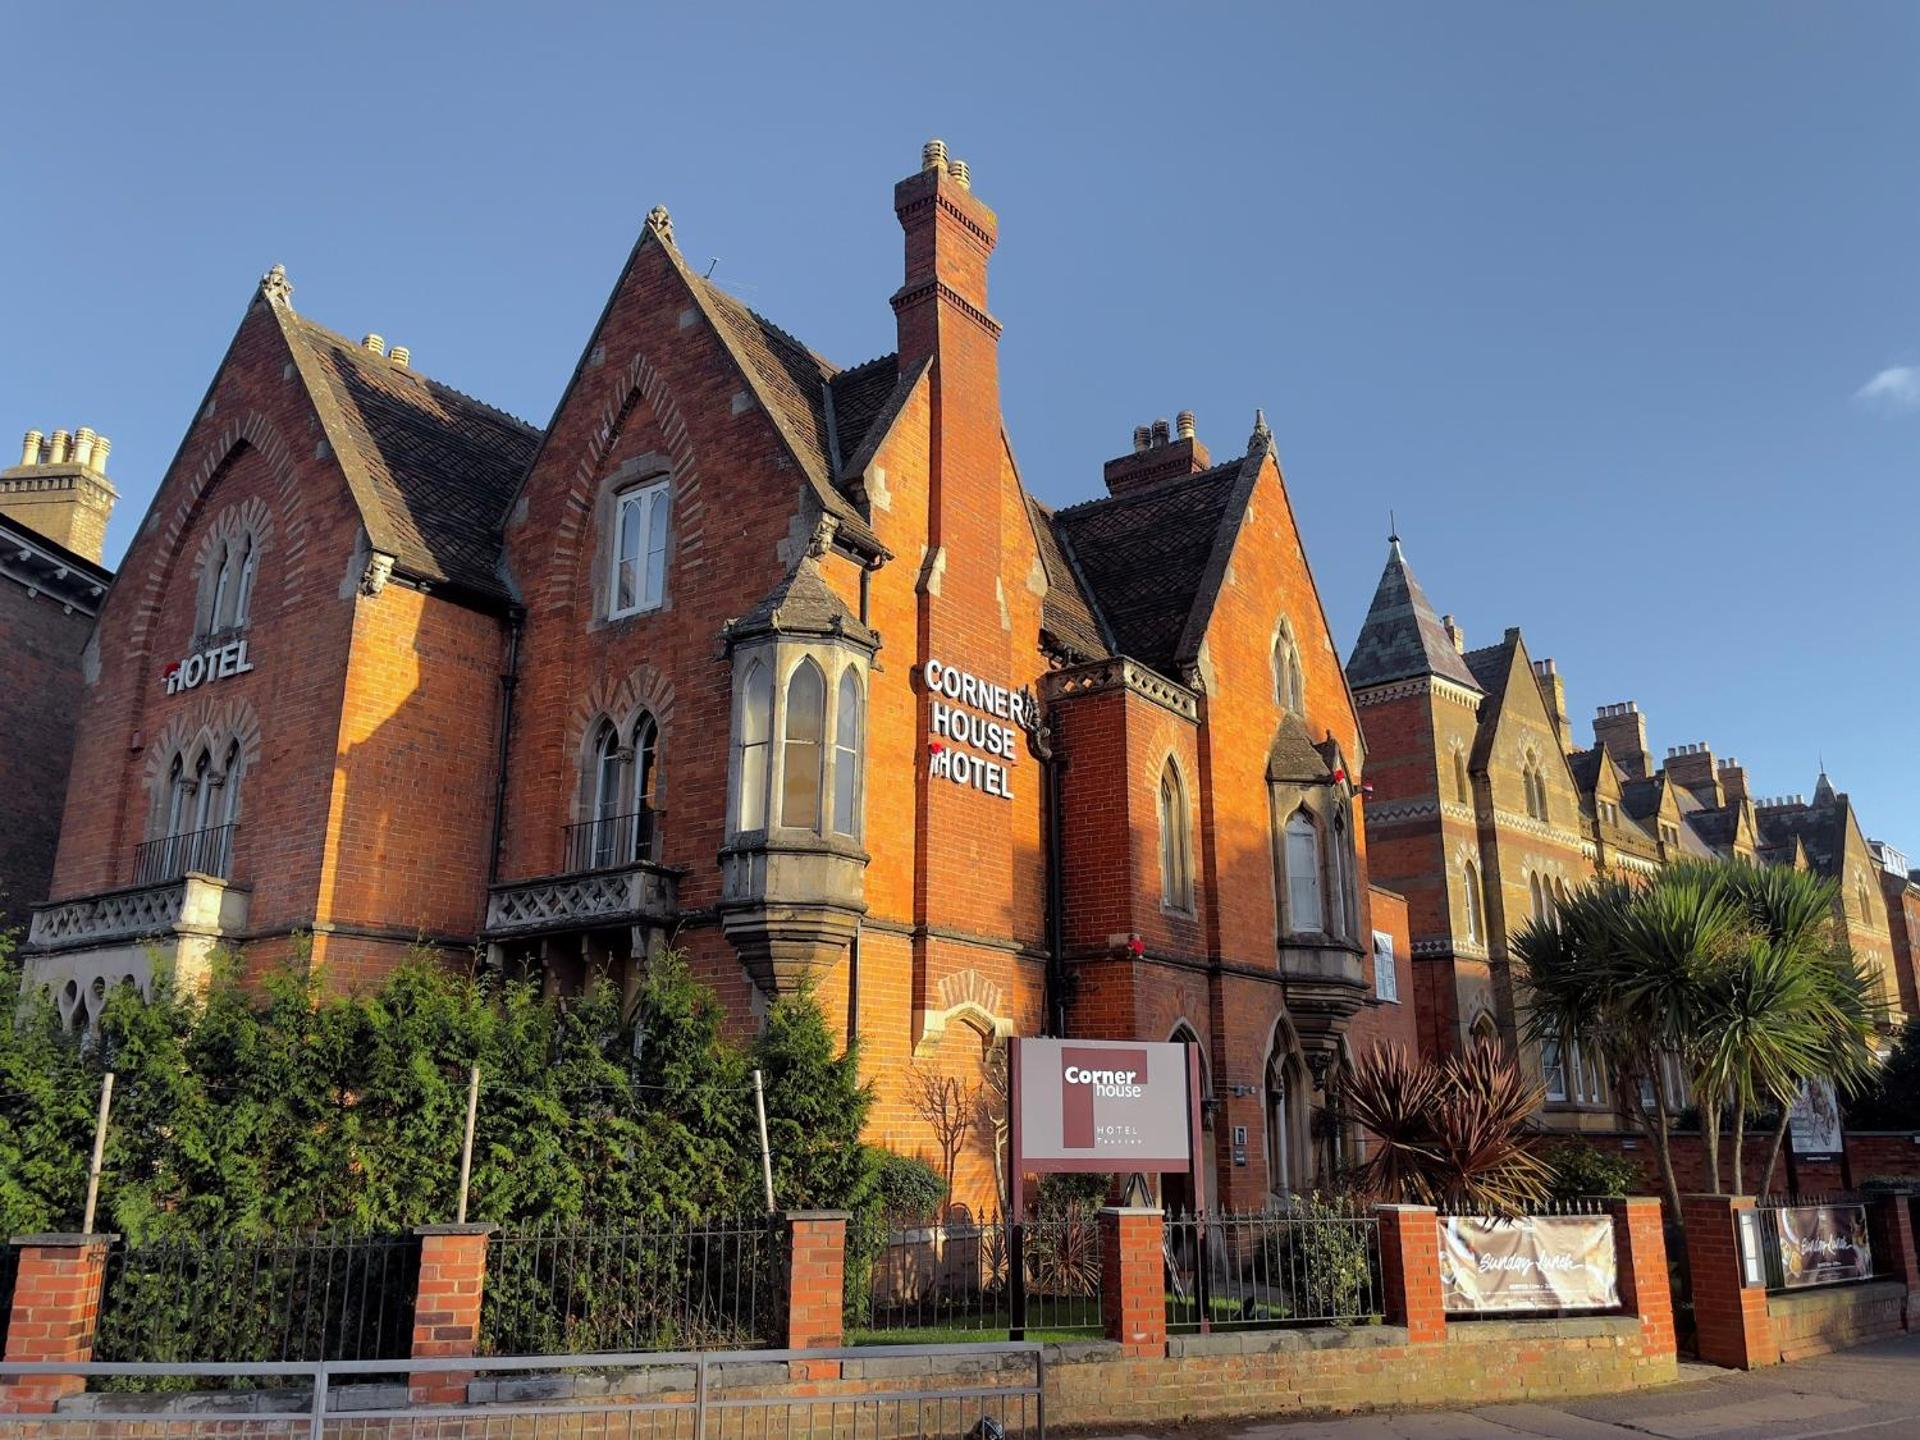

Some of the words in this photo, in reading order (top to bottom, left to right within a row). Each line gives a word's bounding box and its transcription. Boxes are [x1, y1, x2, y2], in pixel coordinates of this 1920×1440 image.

[166, 640, 254, 695] HOTEL
[924, 659, 1026, 728] CORNER
[933, 701, 1016, 760] HOUSE
[931, 747, 1015, 799] HOTEL
[1065, 1066, 1137, 1084] Corner
[1096, 1083, 1142, 1098] house
[1096, 1125, 1137, 1135] HOTEL
[1479, 1252, 1534, 1276] Sunday
